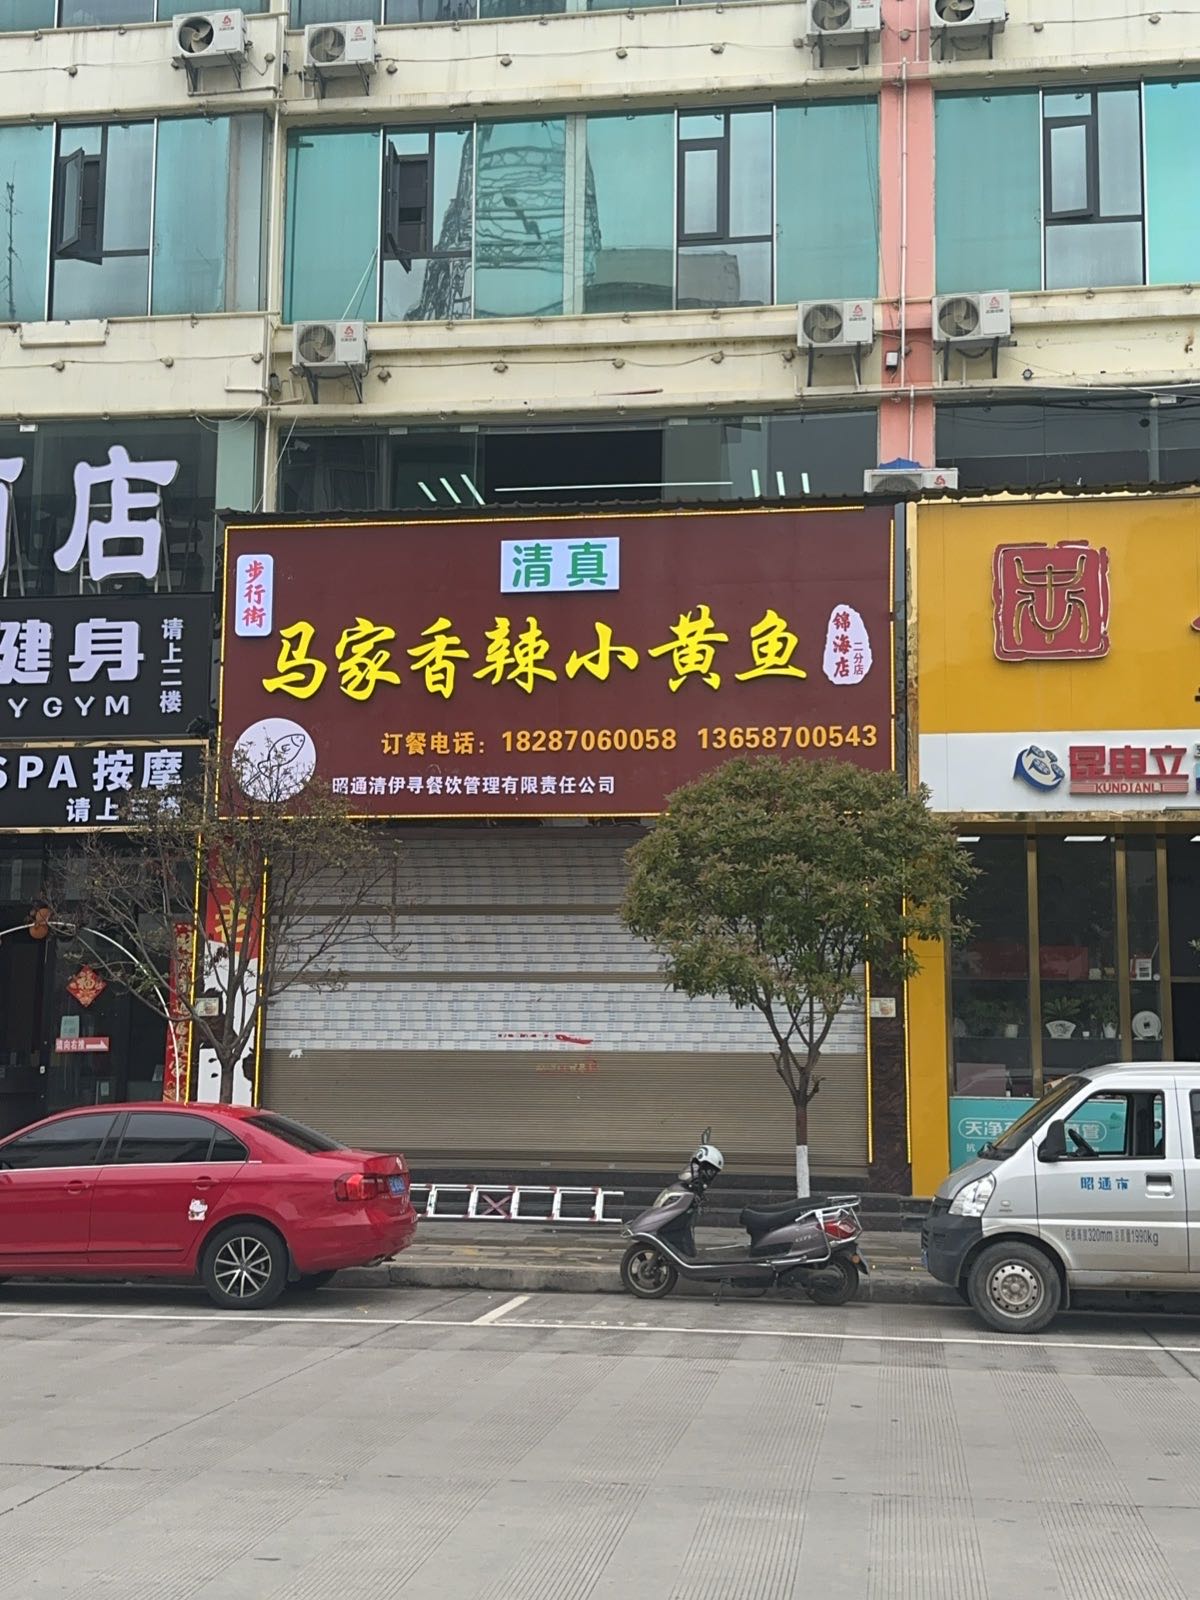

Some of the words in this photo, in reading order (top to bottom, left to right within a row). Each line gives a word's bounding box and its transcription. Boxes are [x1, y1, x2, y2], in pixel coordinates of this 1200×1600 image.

[0, 445, 179, 582] 店
[512, 541, 608, 588] 清真
[242, 560, 266, 629] 步行街
[0, 618, 144, 684] 健身
[159, 617, 184, 713] 请上二楼
[262, 604, 807, 700] 马家香辣小黄鱼
[833, 611, 852, 678] 锦海店
[853, 642, 864, 676] 二分店
[8, 695, 130, 718] YGYM
[502, 729, 677, 752] 18287060058
[697, 725, 877, 750] 13658700543
[92, 748, 183, 792] 按摩
[332, 776, 616, 796] 昭通清伊寻餐饮管理有限责任公司
[1080, 1177, 1129, 1190] 昭通市
